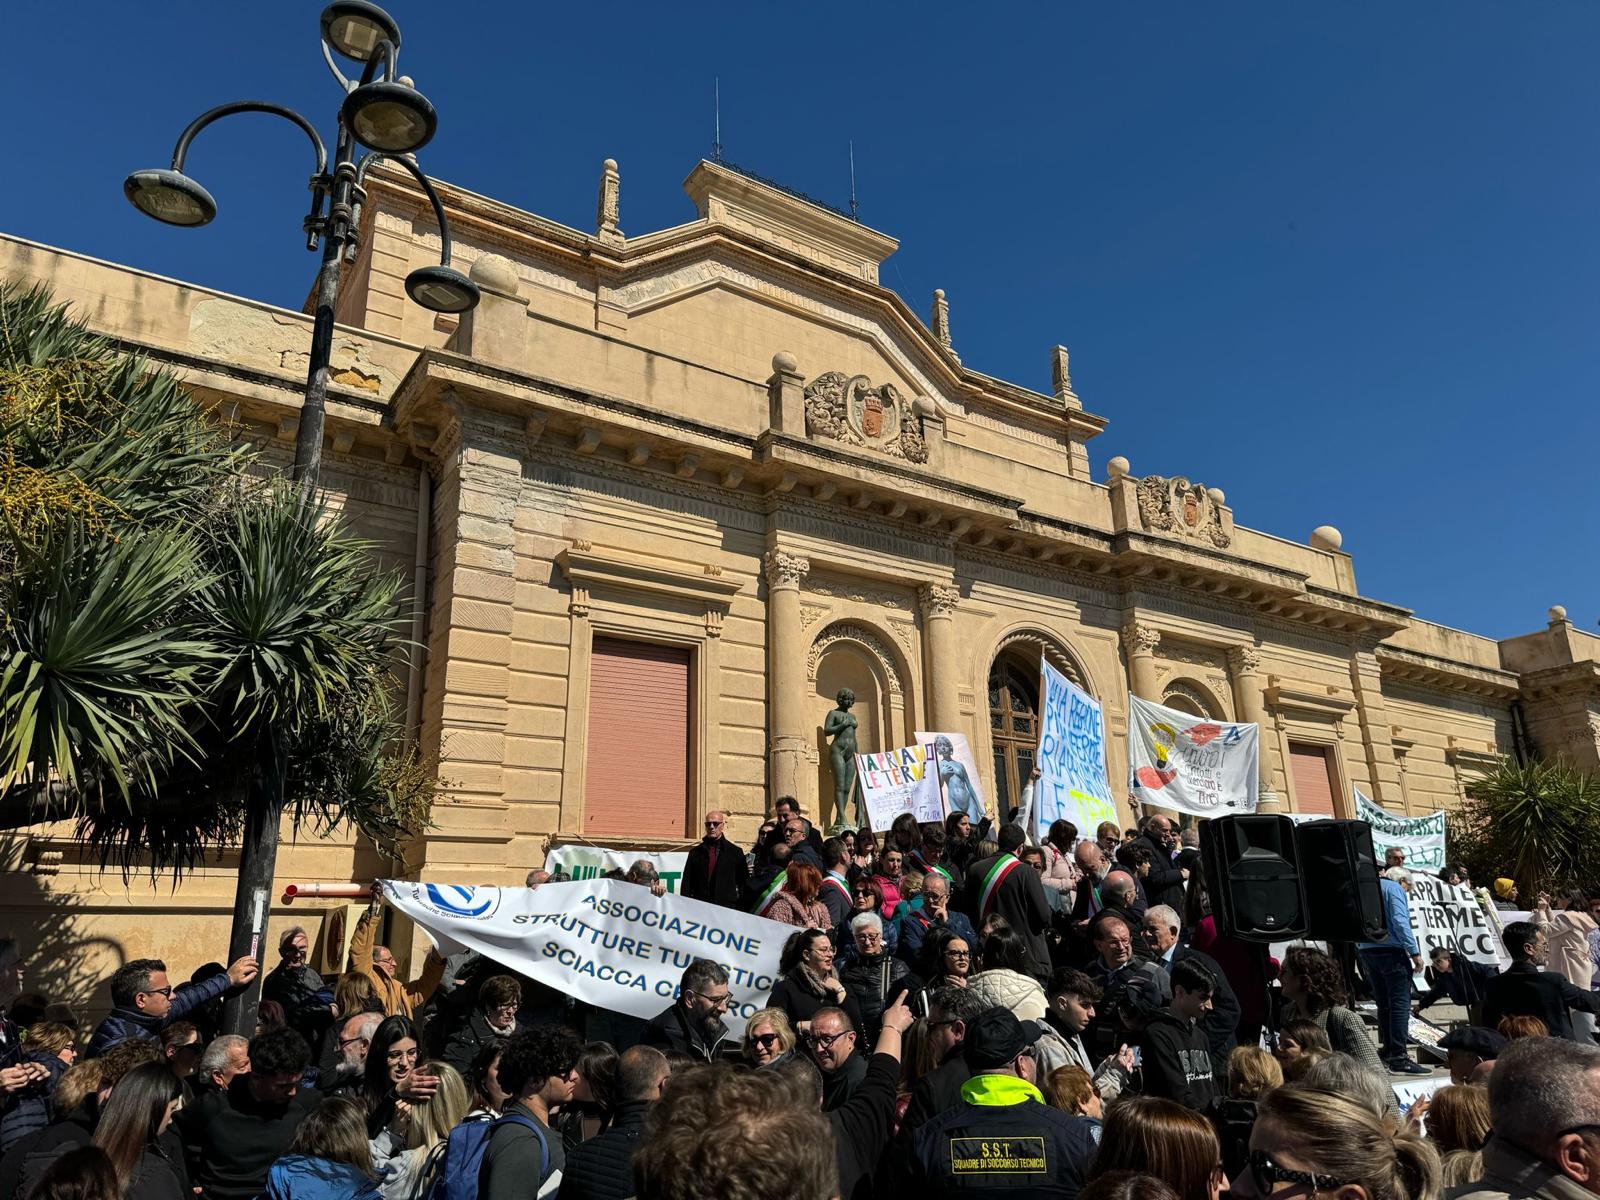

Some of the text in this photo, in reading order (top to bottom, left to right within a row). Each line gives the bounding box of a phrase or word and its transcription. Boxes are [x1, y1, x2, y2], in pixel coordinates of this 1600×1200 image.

[863, 761, 927, 790] LE TERME
[1040, 778, 1066, 824] LE
[512, 912, 653, 960] STRUTTURE
[581, 894, 762, 956] ASSOCIAZIONE
[1418, 906, 1487, 929] TERME
[541, 941, 648, 992] SCIACCA
[953, 1158, 1044, 1169] SQUADRE DI SOCCORSO TECNICO
[981, 1142, 1012, 1158] S.S.T.
